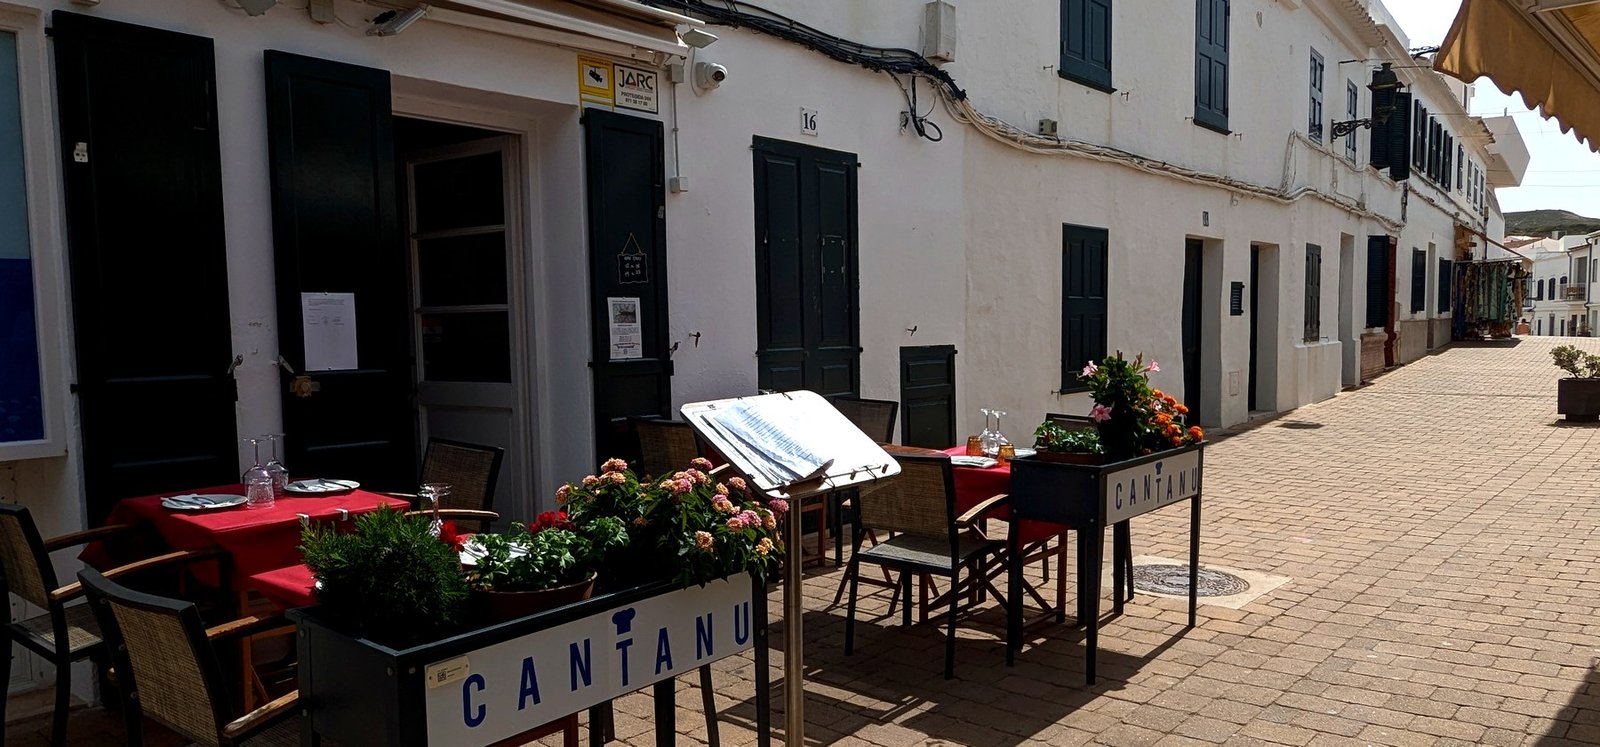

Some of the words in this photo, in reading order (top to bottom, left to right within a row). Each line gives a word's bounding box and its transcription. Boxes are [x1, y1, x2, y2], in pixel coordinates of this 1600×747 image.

[619, 69, 653, 90] JARC
[620, 91, 644, 100] PROTEGIDA
[803, 112, 816, 131] 16
[1115, 467, 1198, 510] CANTANU
[462, 601, 750, 728] CANTANU
